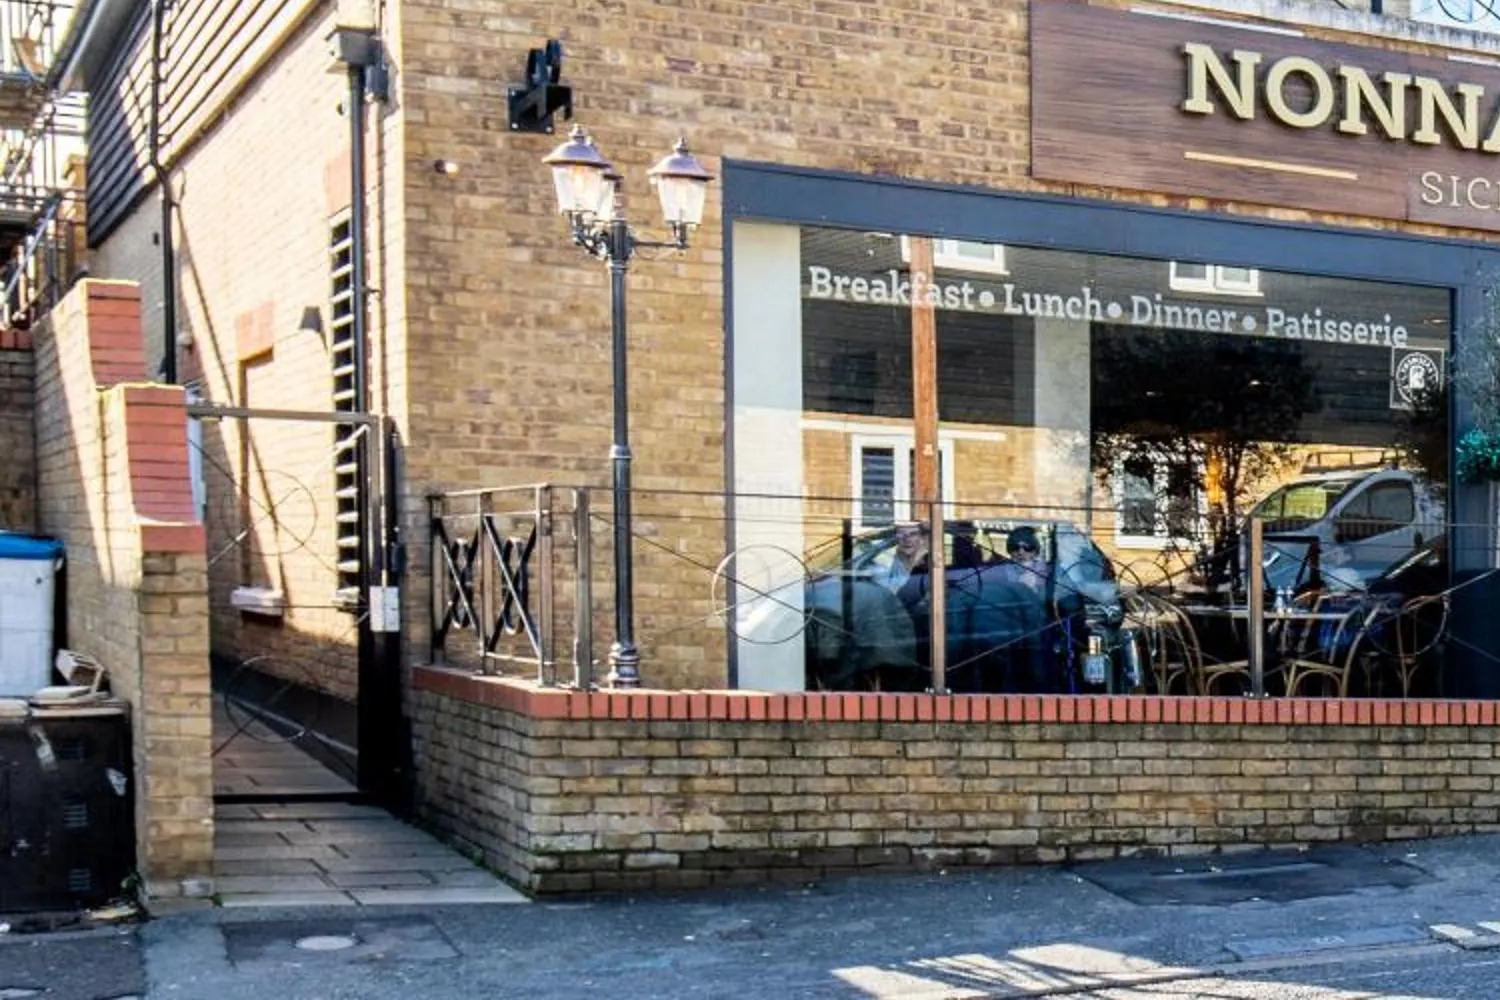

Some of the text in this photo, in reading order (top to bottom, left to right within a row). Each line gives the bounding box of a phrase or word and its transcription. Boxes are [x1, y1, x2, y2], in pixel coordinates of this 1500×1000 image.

[808, 265, 1408, 349] Breakfast Lunch Dinner Patisserie
